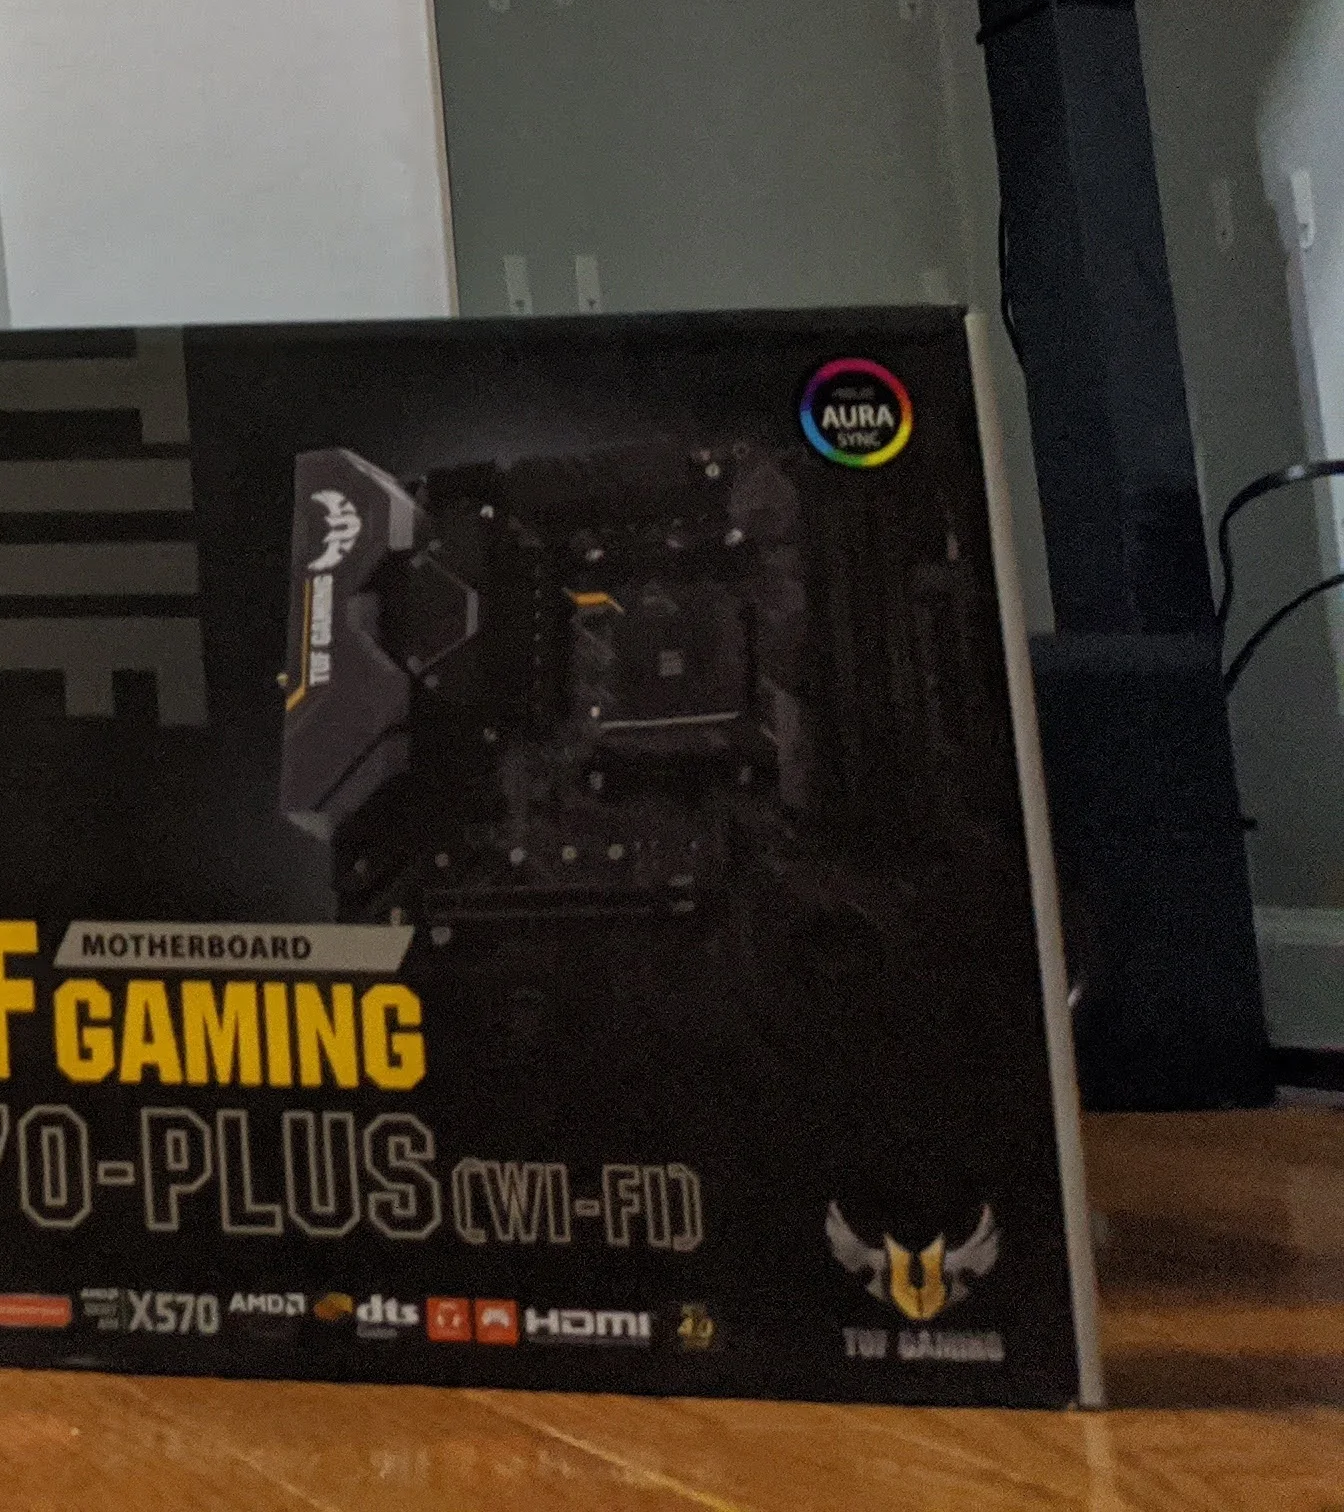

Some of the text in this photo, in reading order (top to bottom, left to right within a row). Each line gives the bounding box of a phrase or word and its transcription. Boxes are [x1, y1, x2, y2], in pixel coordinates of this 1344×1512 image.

[821, 402, 895, 429] AURA
[81, 932, 312, 961] MOTHERBOARD
[53, 978, 427, 1091] GAMING
[450, 1155, 704, 1253] (WI-FI)
[129, 1290, 221, 1335] X570
[228, 1291, 283, 1314] AMD
[355, 1293, 420, 1324] dts
[523, 1307, 651, 1337] HDMI
